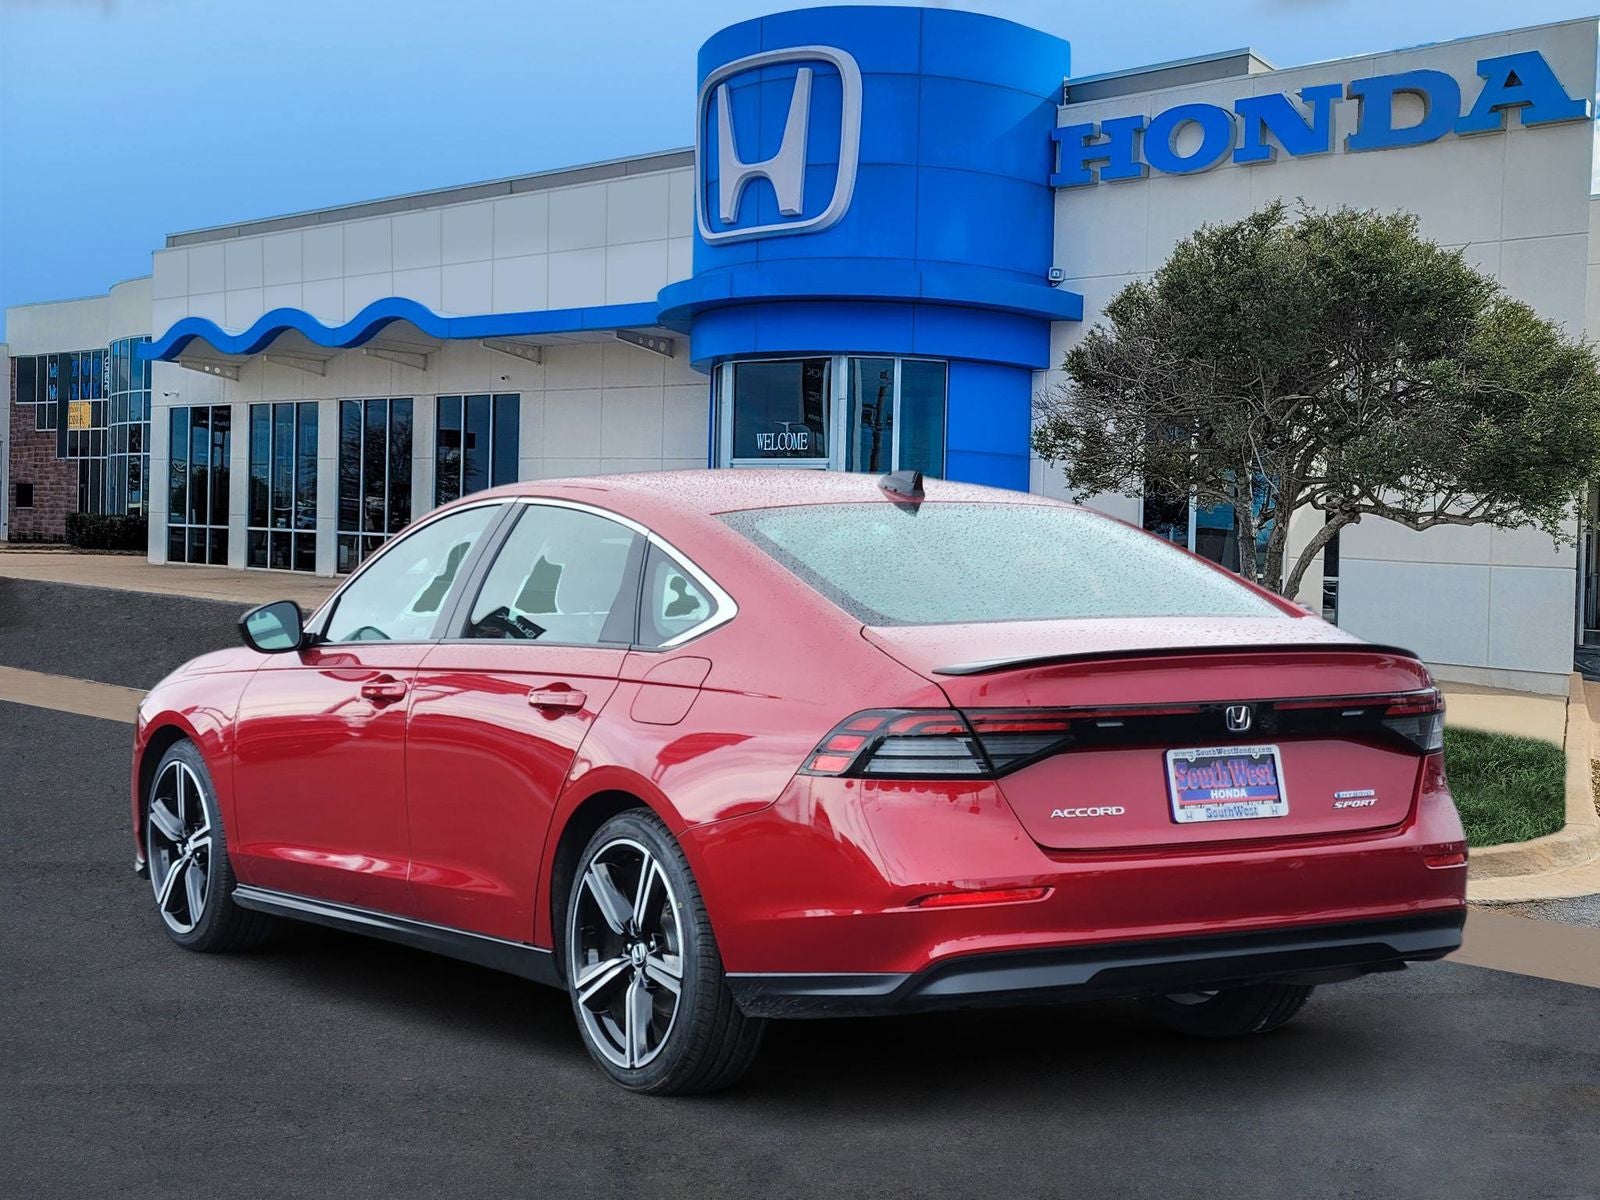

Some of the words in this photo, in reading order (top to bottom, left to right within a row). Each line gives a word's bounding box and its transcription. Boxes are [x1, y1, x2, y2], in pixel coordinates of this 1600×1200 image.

[1051, 50, 1590, 188] HONDA
[756, 432, 808, 451] WELCOME
[1210, 788, 1248, 800] HONDA
[1332, 798, 1379, 809] SPORT
[1050, 805, 1125, 818] ACCORD
